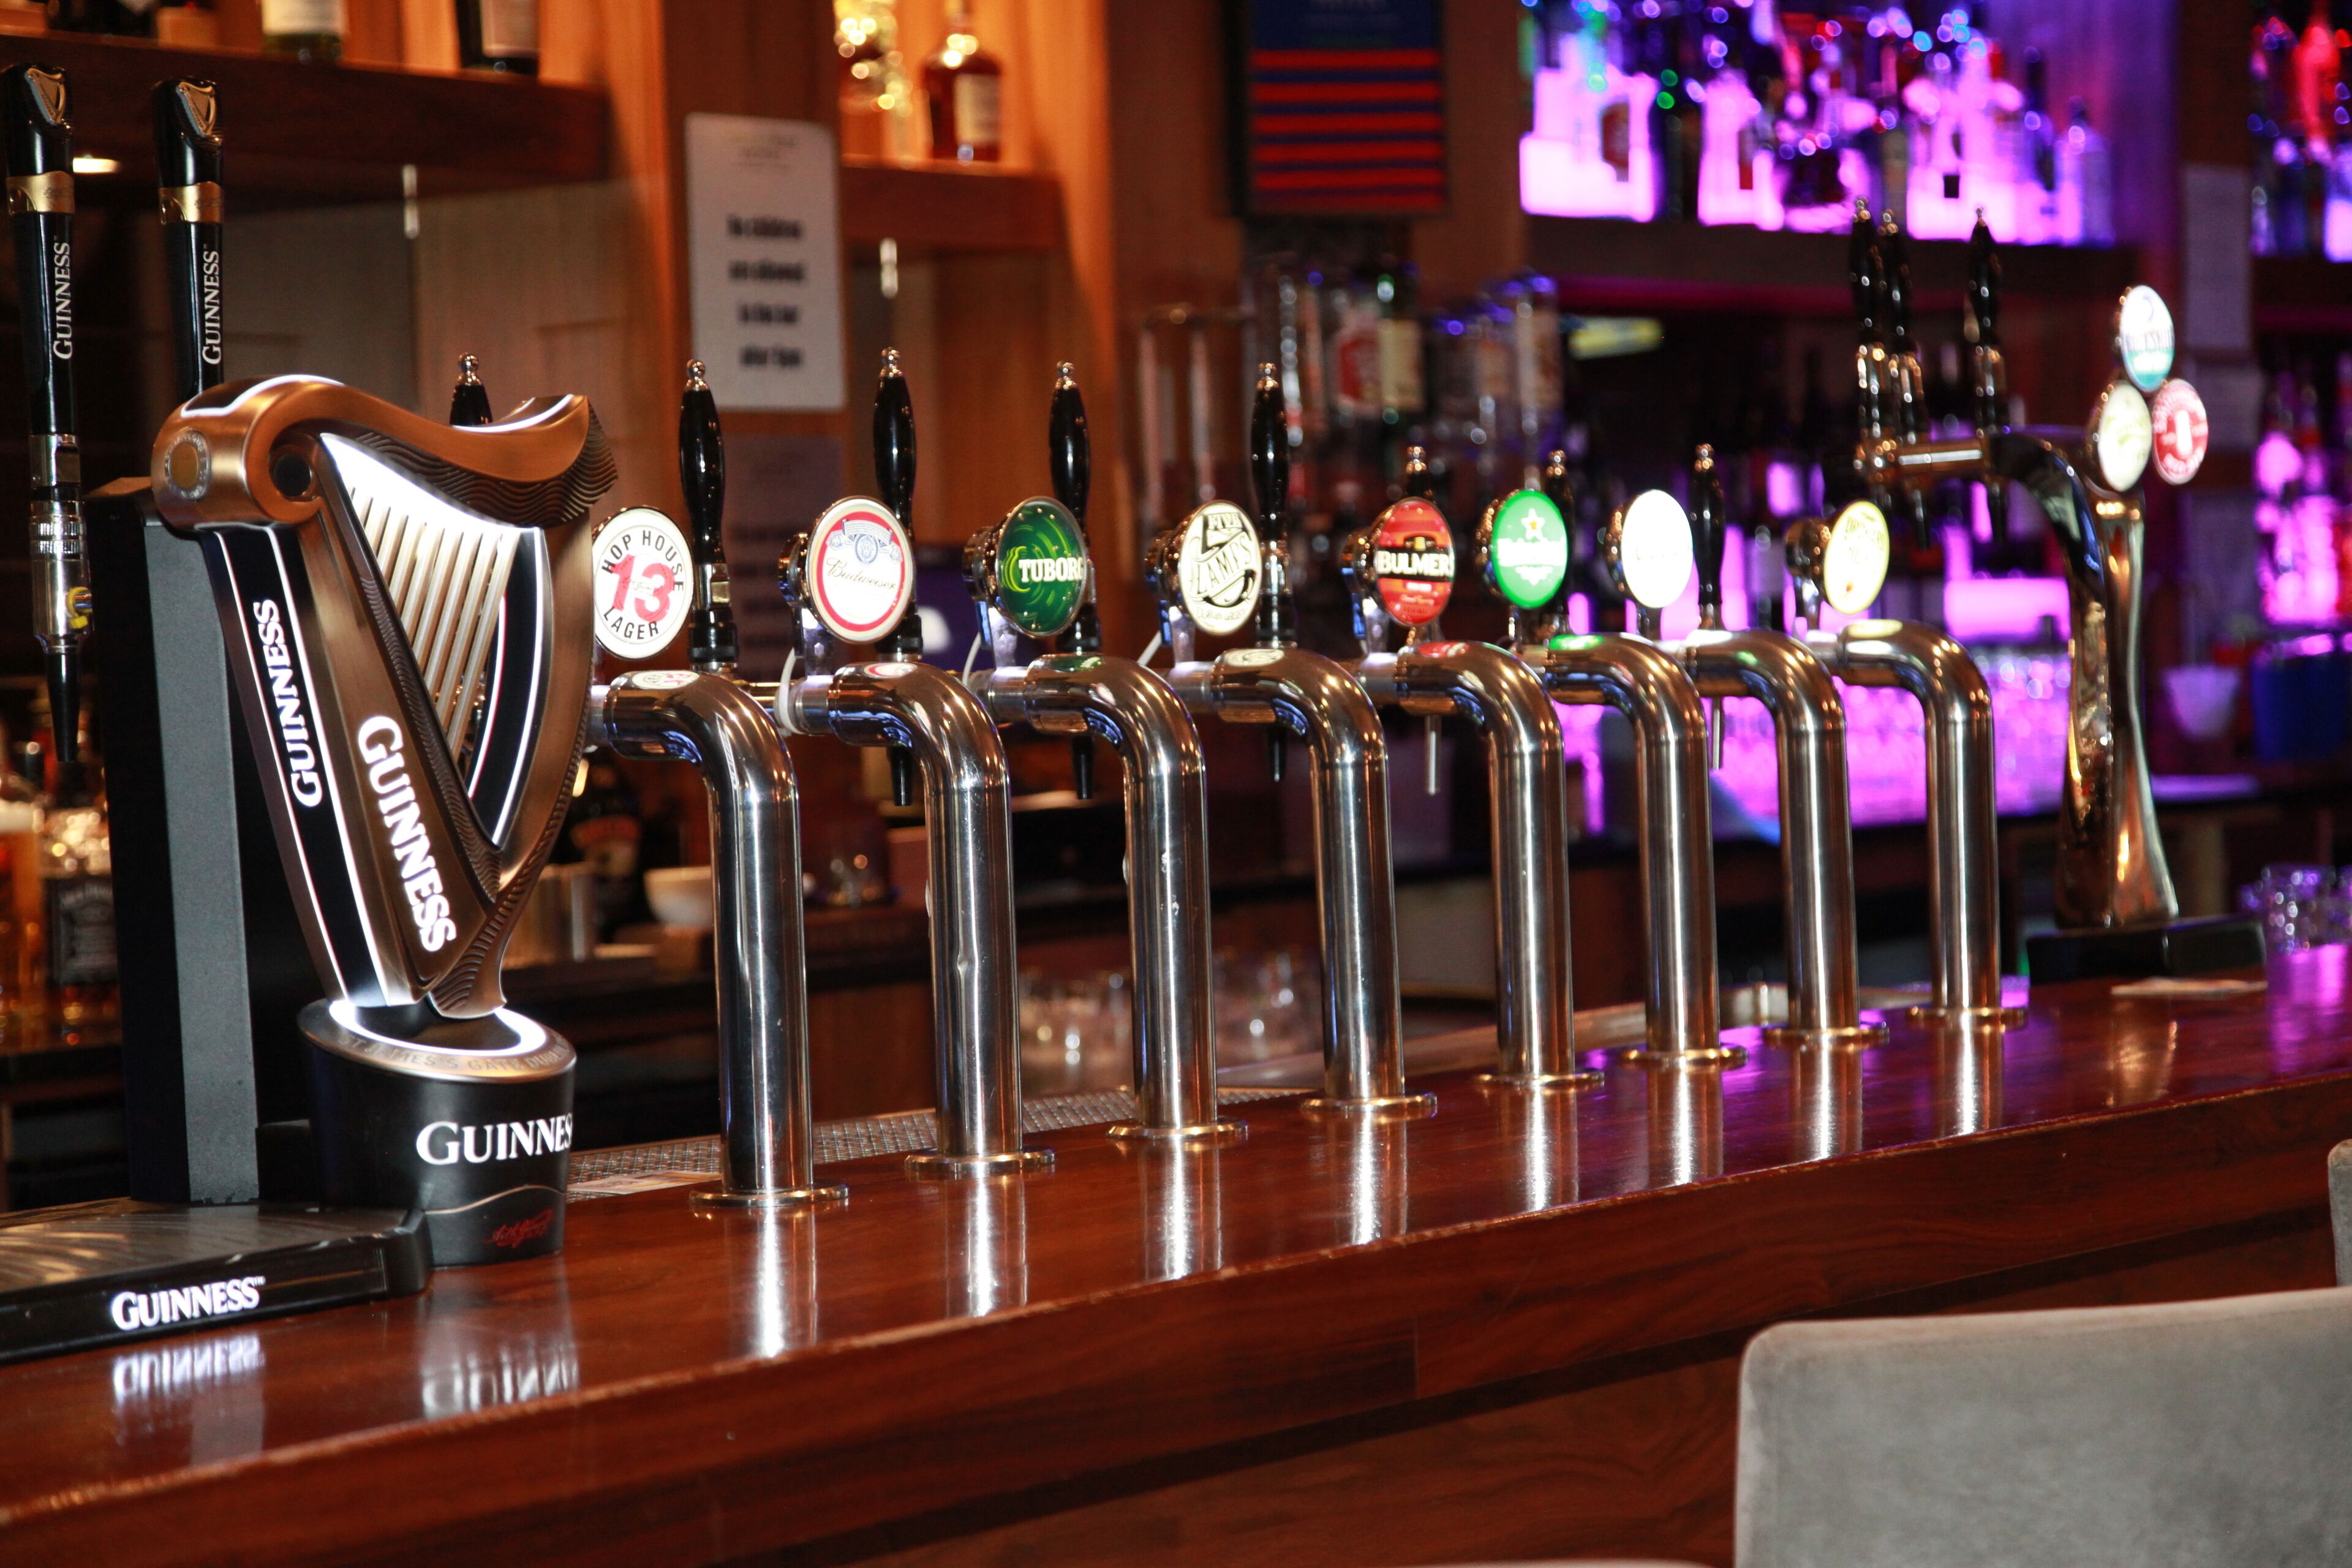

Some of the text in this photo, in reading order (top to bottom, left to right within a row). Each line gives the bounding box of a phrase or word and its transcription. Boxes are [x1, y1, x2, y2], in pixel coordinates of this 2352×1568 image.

[1207, 513, 1243, 530] FIVE
[601, 530, 684, 592] HOP HOUSE
[609, 554, 676, 624] 13
[826, 557, 896, 590] Budweiser
[603, 606, 659, 640] LAGER
[252, 598, 323, 807] GUINNESS
[358, 715, 457, 952] GUINNESS
[416, 1112, 573, 1166] GUINNES
